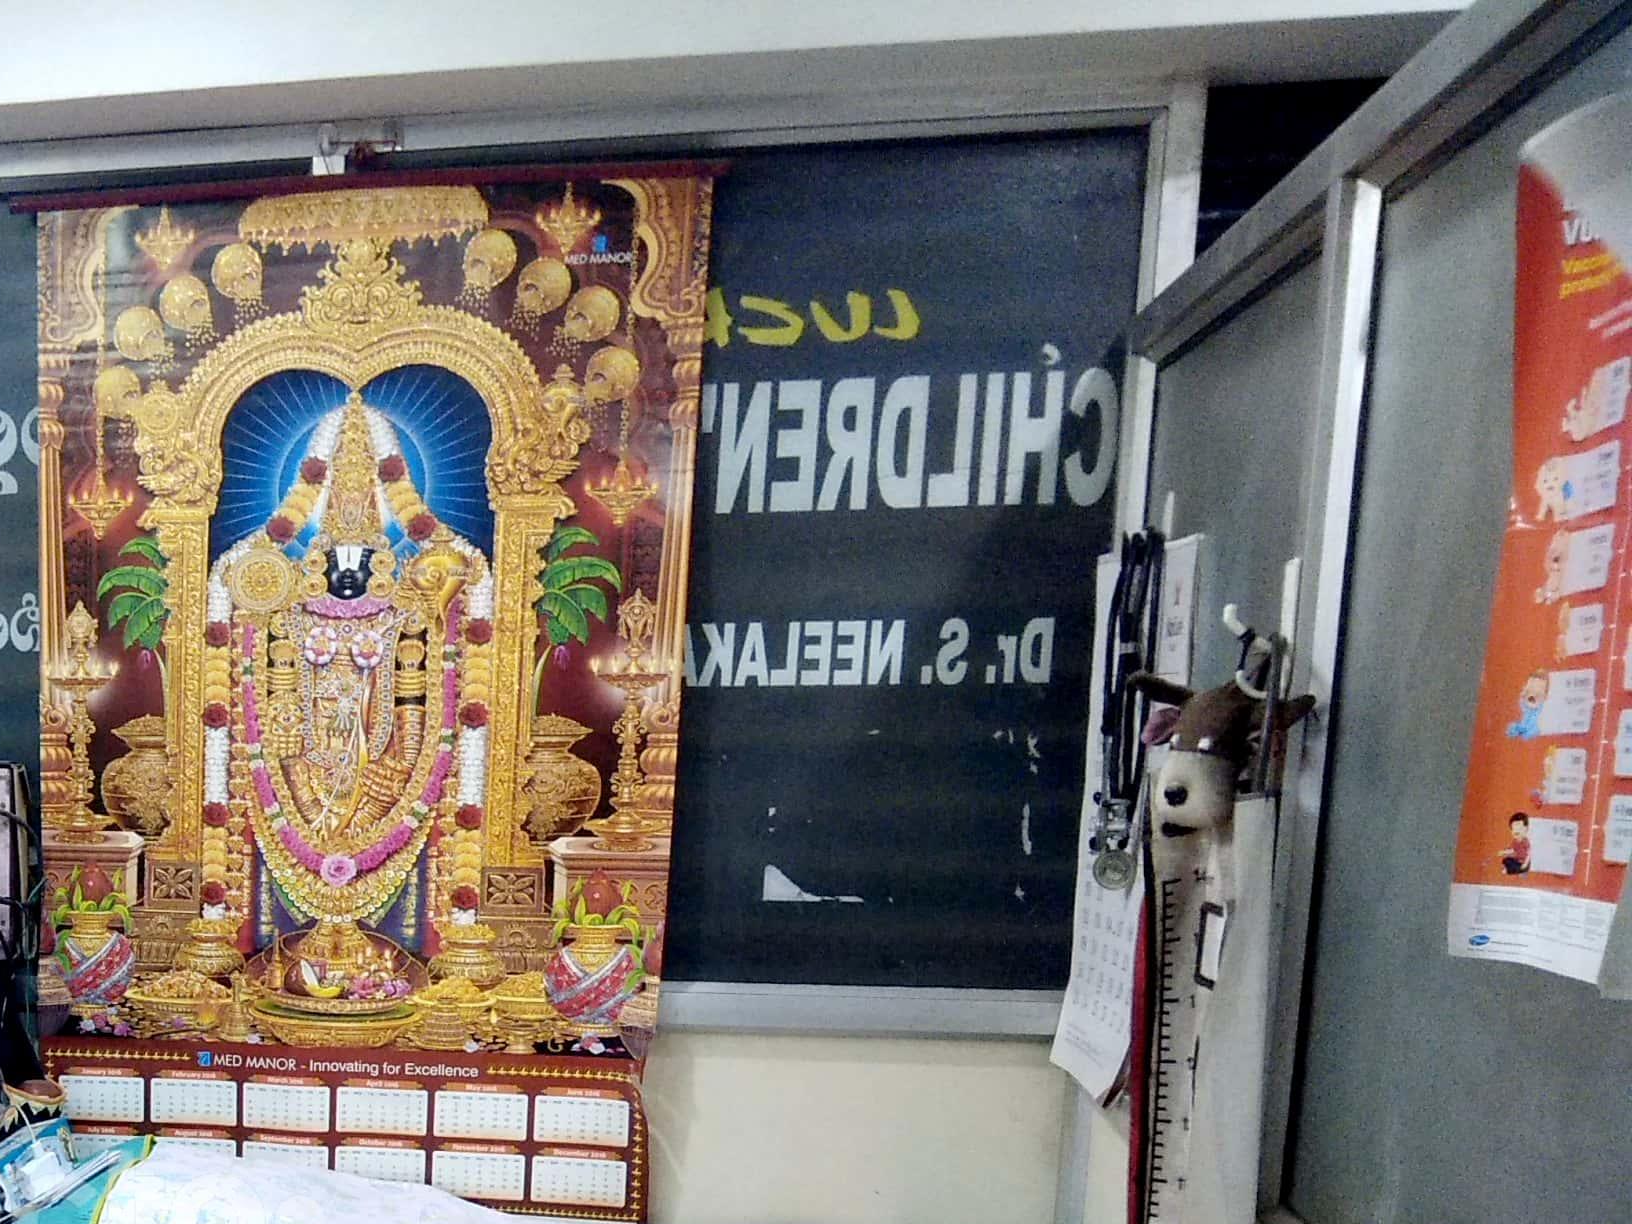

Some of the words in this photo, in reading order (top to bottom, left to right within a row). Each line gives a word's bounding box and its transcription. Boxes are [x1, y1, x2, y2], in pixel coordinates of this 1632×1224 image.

[213, 1054, 243, 1067] MED
[245, 1058, 297, 1071] MANOR
[309, 1059, 379, 1077] Innovating
[382, 1061, 401, 1076] for
[404, 1064, 480, 1079] Excellence
